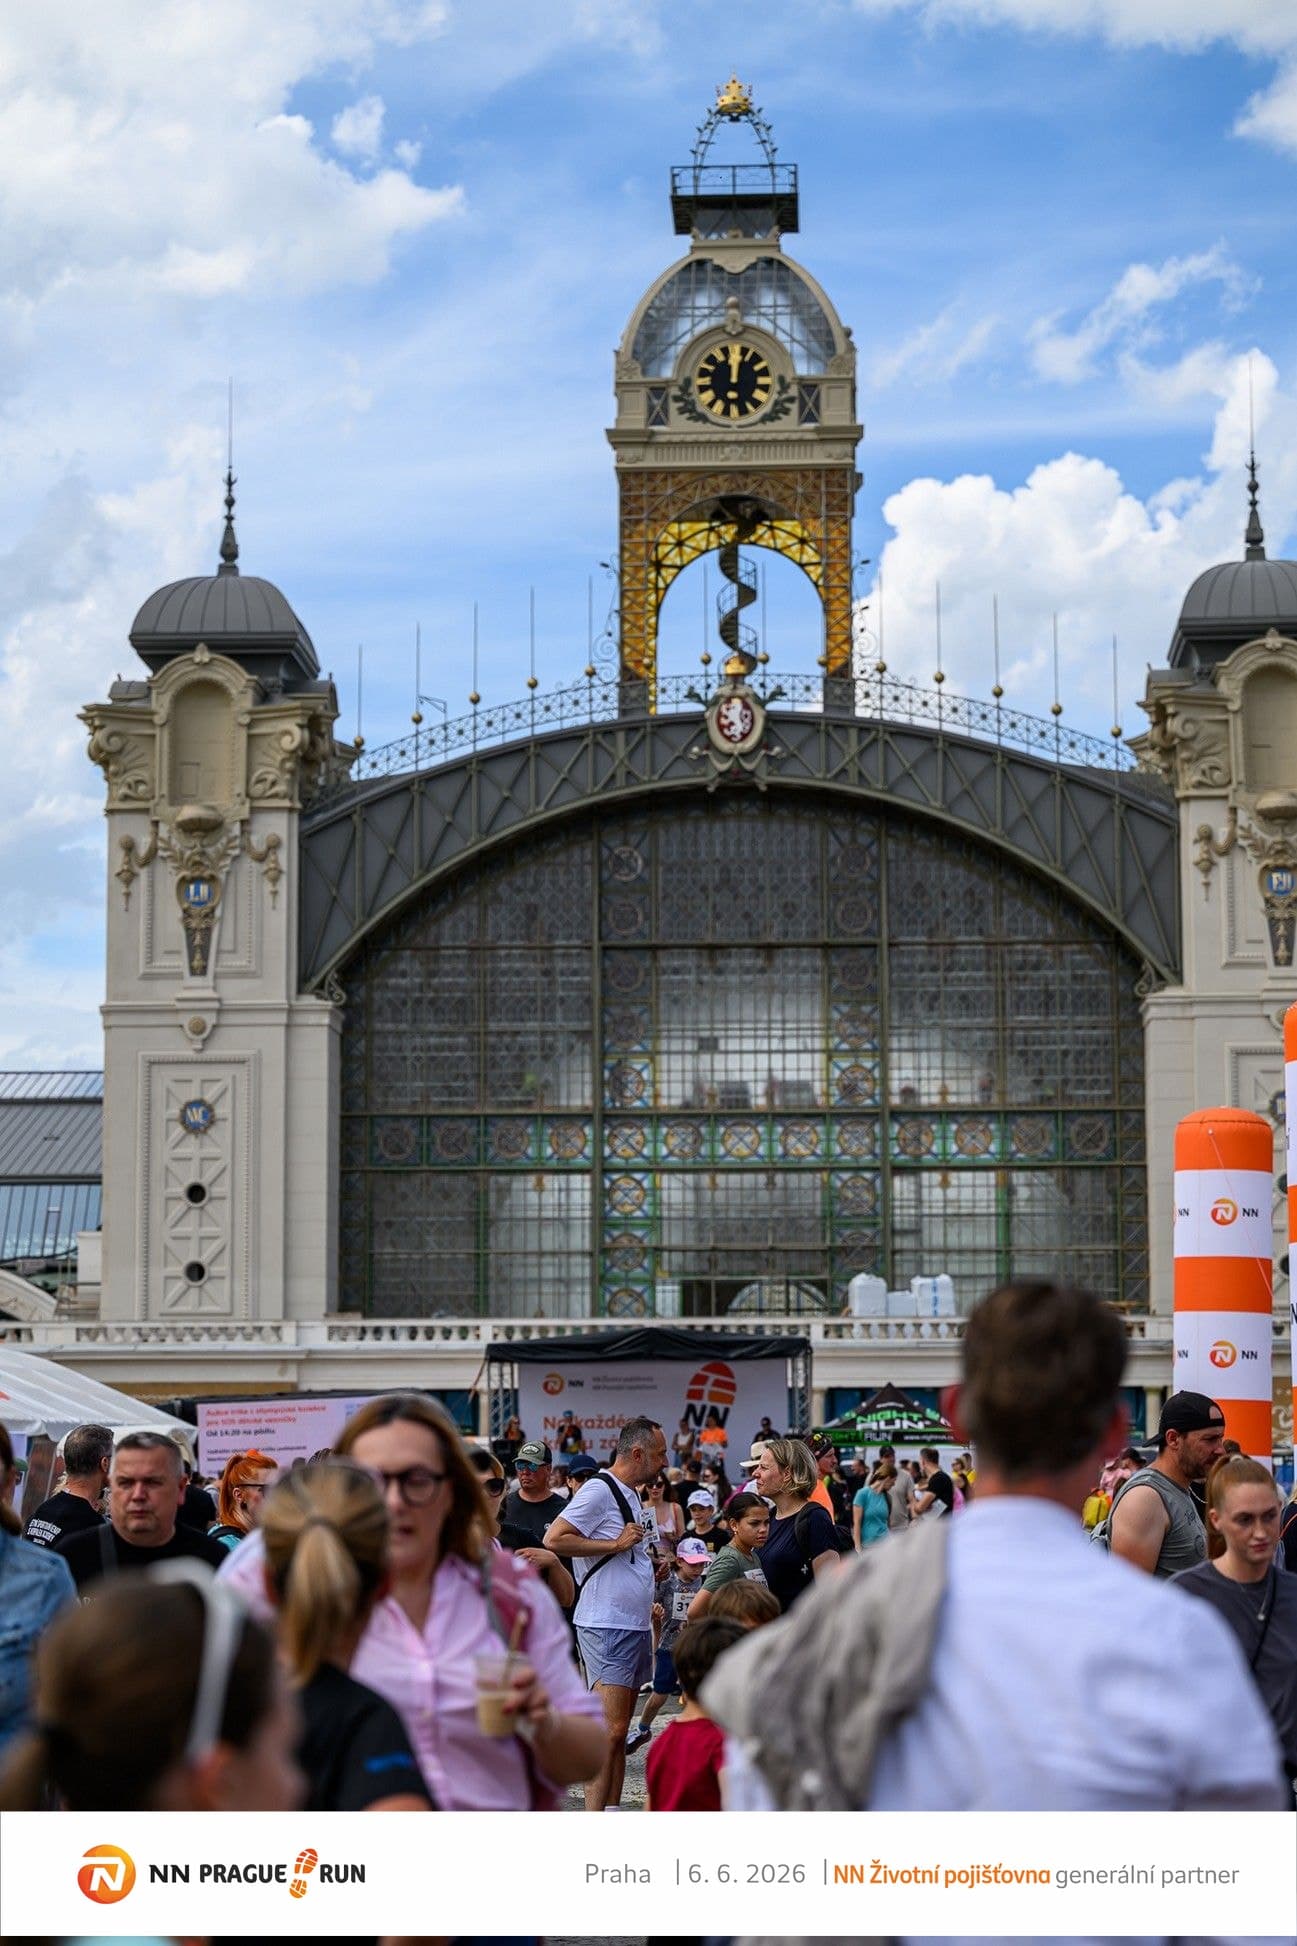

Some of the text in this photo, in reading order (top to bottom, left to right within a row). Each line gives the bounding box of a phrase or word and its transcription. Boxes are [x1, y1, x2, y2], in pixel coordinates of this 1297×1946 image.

[1241, 1207, 1259, 1218] NN
[1241, 1349, 1258, 1360] NN
[856, 1409, 923, 1425] NIGHT
